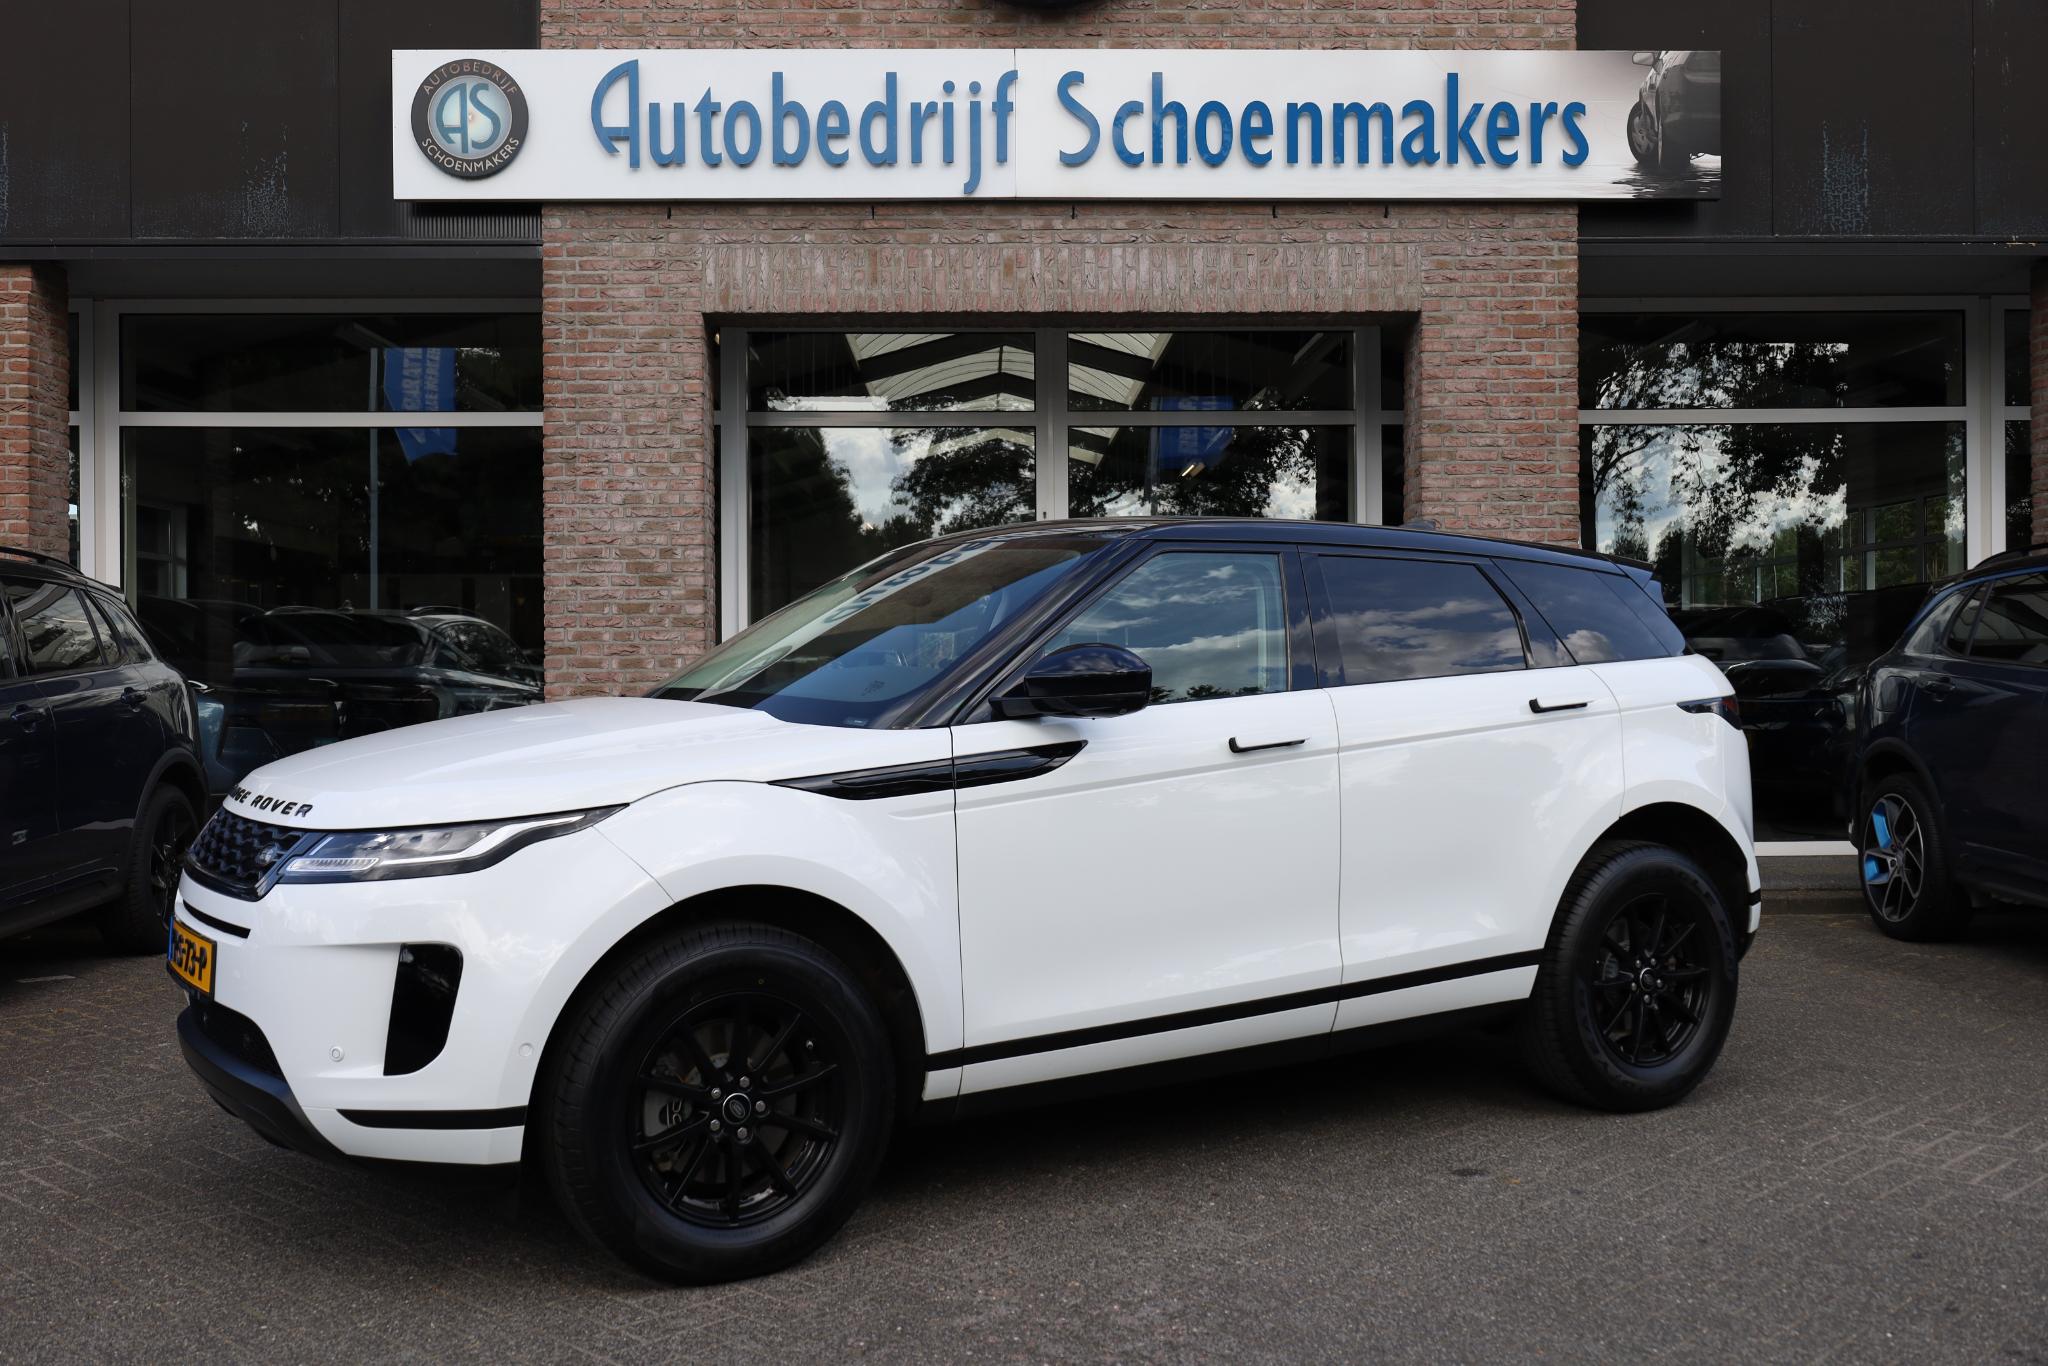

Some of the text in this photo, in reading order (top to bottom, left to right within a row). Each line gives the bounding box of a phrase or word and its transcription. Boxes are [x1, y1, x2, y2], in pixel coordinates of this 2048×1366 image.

[423, 61, 518, 96] AUTOBEDRIJF
[435, 82, 501, 154] AS
[591, 59, 1590, 196] Autobedrijf Schoenmakers
[422, 137, 520, 173] SCHOENMAKERS
[250, 794, 313, 818] ROVER
